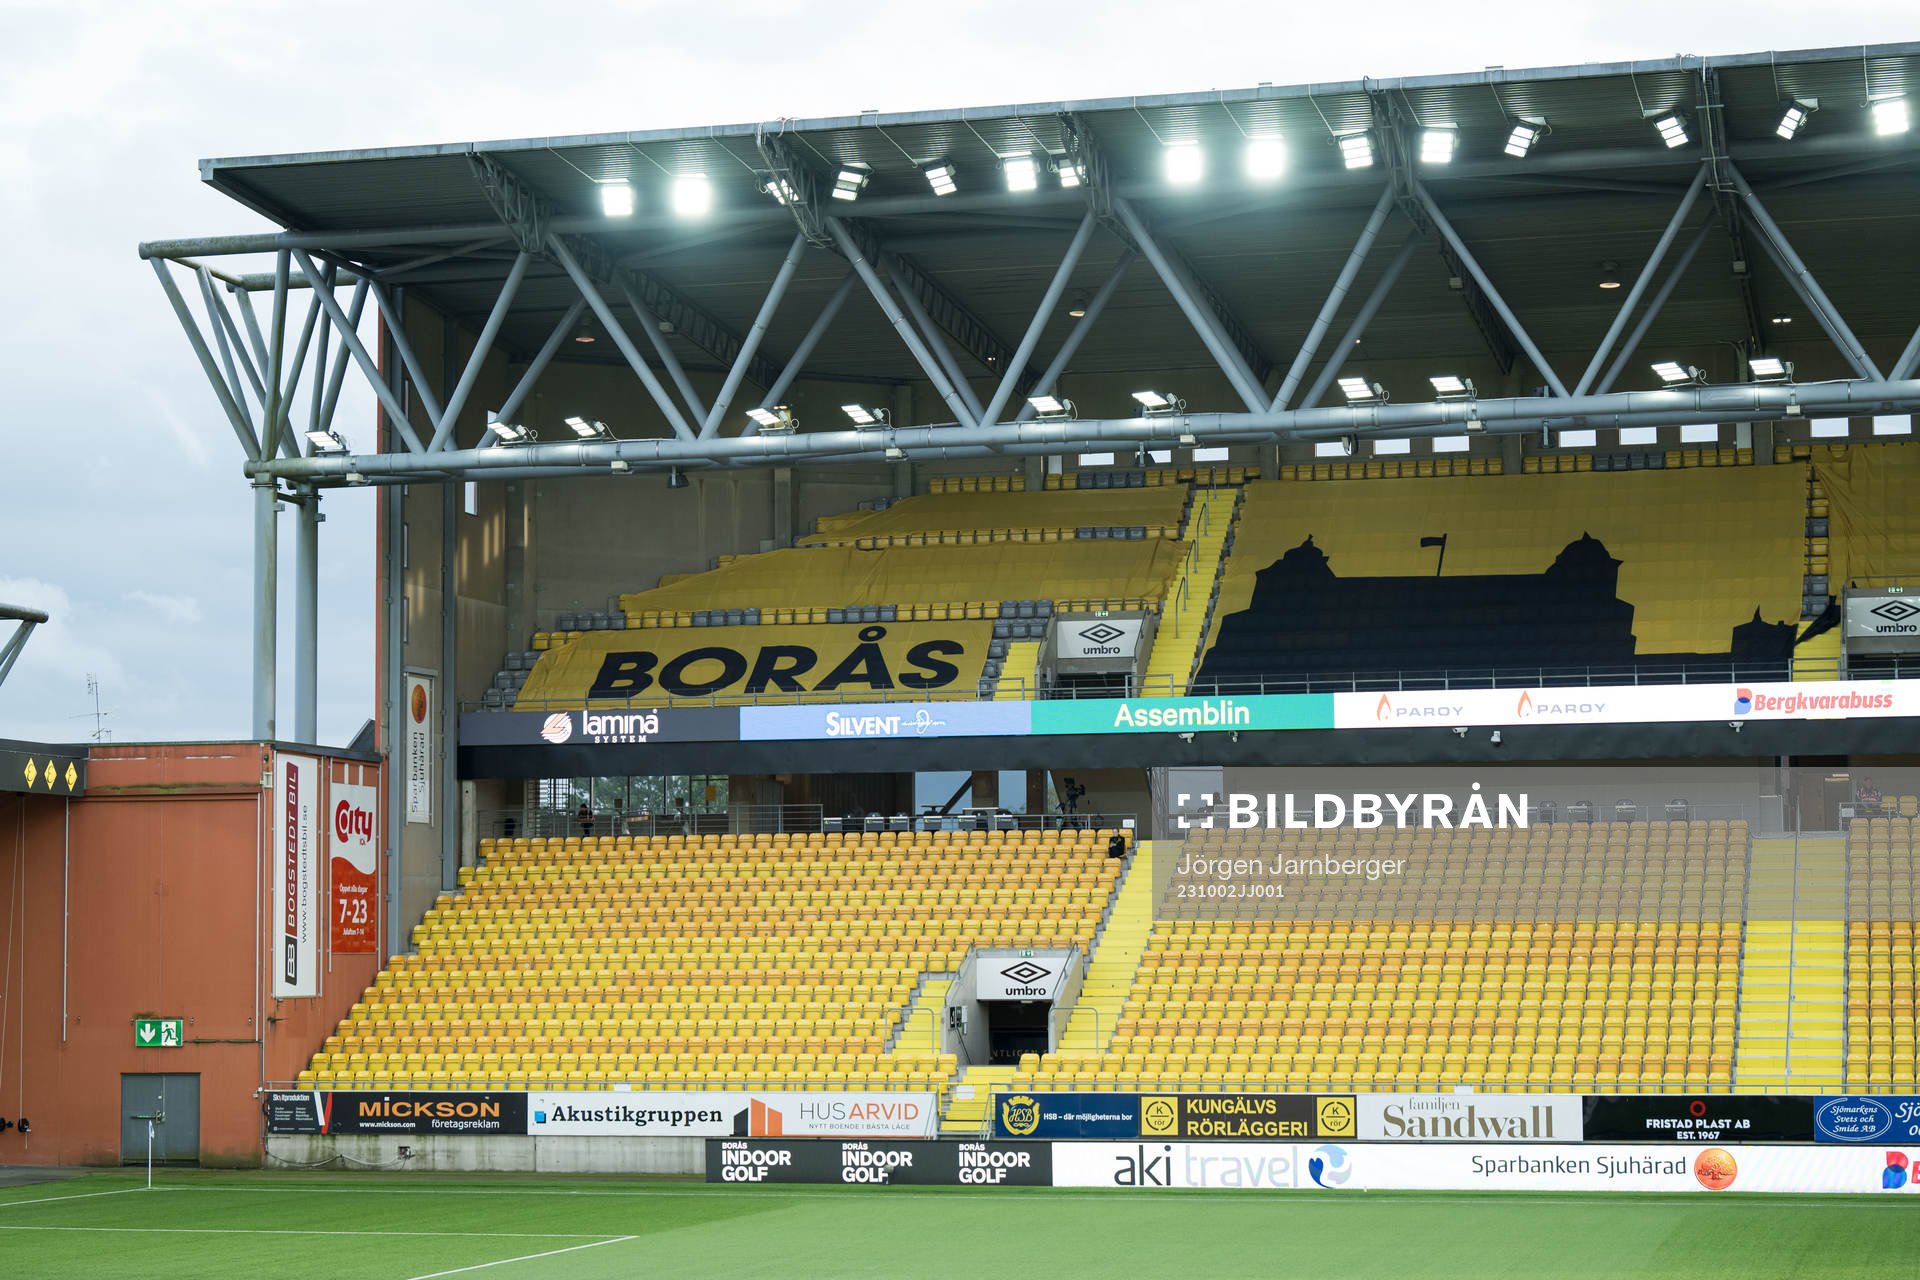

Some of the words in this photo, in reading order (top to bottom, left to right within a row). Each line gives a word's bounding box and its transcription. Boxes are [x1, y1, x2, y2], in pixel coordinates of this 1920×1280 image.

[1875, 622, 1917, 634] umbro
[1083, 645, 1121, 656] umbro
[588, 626, 965, 699] BORÅS
[1754, 691, 1893, 714] Bergkvarabuss
[1114, 700, 1250, 727] Assemblin
[826, 711, 901, 736] SILVENT
[594, 735, 647, 743] SYSTEM
[288, 771, 296, 805] BIL
[288, 812, 296, 928] BOGSTEDT
[339, 899, 368, 924] 7-23
[1005, 986, 1047, 995] umbro
[1156, 1106, 1163, 1114] K
[1186, 1097, 1277, 1114] KUNGÄLVS
[1332, 1107, 1339, 1115] K
[1409, 1097, 1460, 1114] familjen
[1830, 1105, 1878, 1115] Sjömarkens
[552, 1106, 723, 1126] Akustikgruppen
[1008, 1108, 1033, 1123] HSB
[1076, 1113, 1120, 1122] möjligheterna
[1383, 1104, 1556, 1138] Sandwall
[1860, 1115, 1874, 1123] och
[431, 1119, 500, 1130] företagsreklam
[866, 1122, 889, 1130] BÄSTA
[891, 1122, 910, 1130] LÄGE
[1187, 1118, 1308, 1136] RÖRLÄGGERI
[1646, 1119, 1693, 1129] FRISTAD
[1696, 1119, 1731, 1129] PLAST
[1734, 1119, 1751, 1129] AB
[1832, 1124, 1859, 1133] Smide
[1860, 1125, 1876, 1133] AB
[1677, 1131, 1696, 1139] EST.
[1698, 1131, 1720, 1139] 1967
[722, 1142, 747, 1150] BORÅS
[959, 1143, 985, 1151] BORÅS
[722, 1150, 791, 1166] INDOOR
[842, 1151, 912, 1167] INDOOR
[959, 1151, 1030, 1167] INDOOR
[1113, 1144, 1172, 1186] aki
[1185, 1144, 1299, 1187] travel
[722, 1166, 768, 1182] GOLF
[1471, 1155, 1590, 1177] Sparbanken
[1596, 1156, 1686, 1178] Sjuhärad
[842, 1167, 889, 1183] GOLF
[959, 1167, 1006, 1183] GOLF
